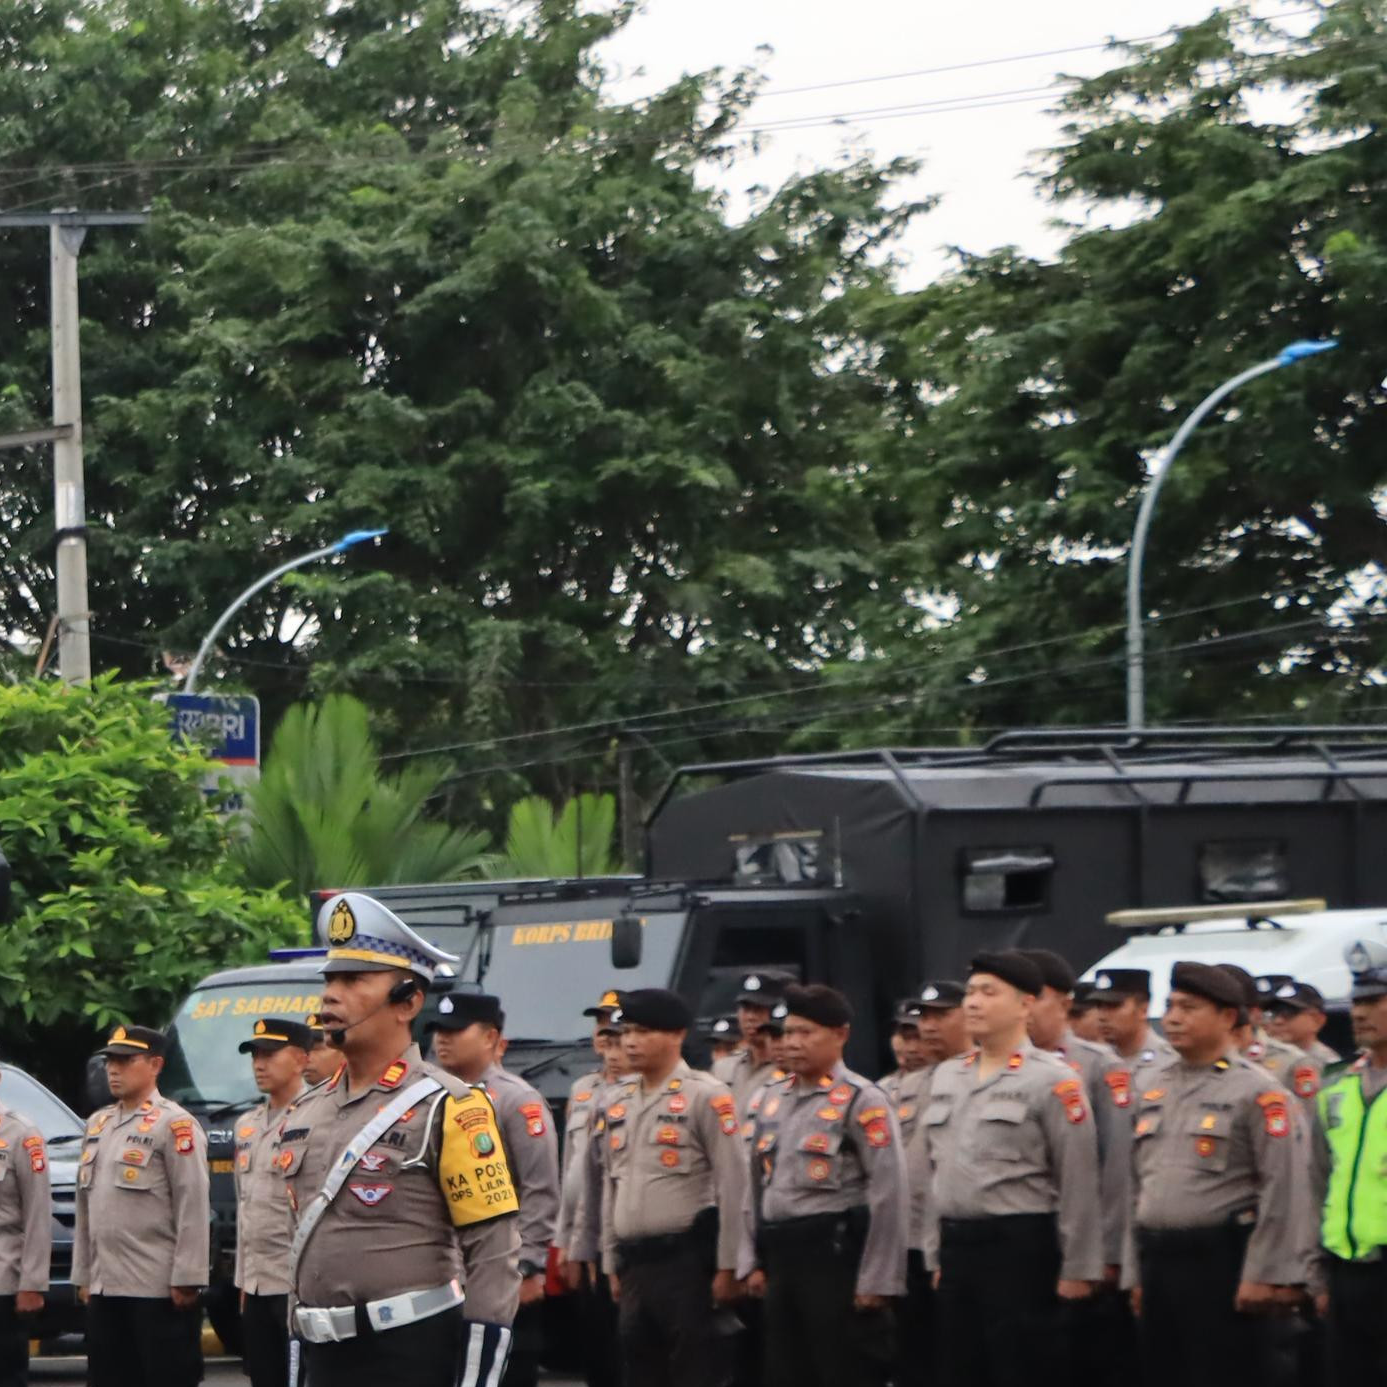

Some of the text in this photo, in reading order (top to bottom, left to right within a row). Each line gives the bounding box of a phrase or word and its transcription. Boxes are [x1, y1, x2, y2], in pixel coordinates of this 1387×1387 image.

[192, 994, 323, 1020] SAT SABHAR
[126, 1135, 153, 1146] POLRI
[446, 1173, 469, 1190] KA
[451, 1188, 473, 1202] OPS
